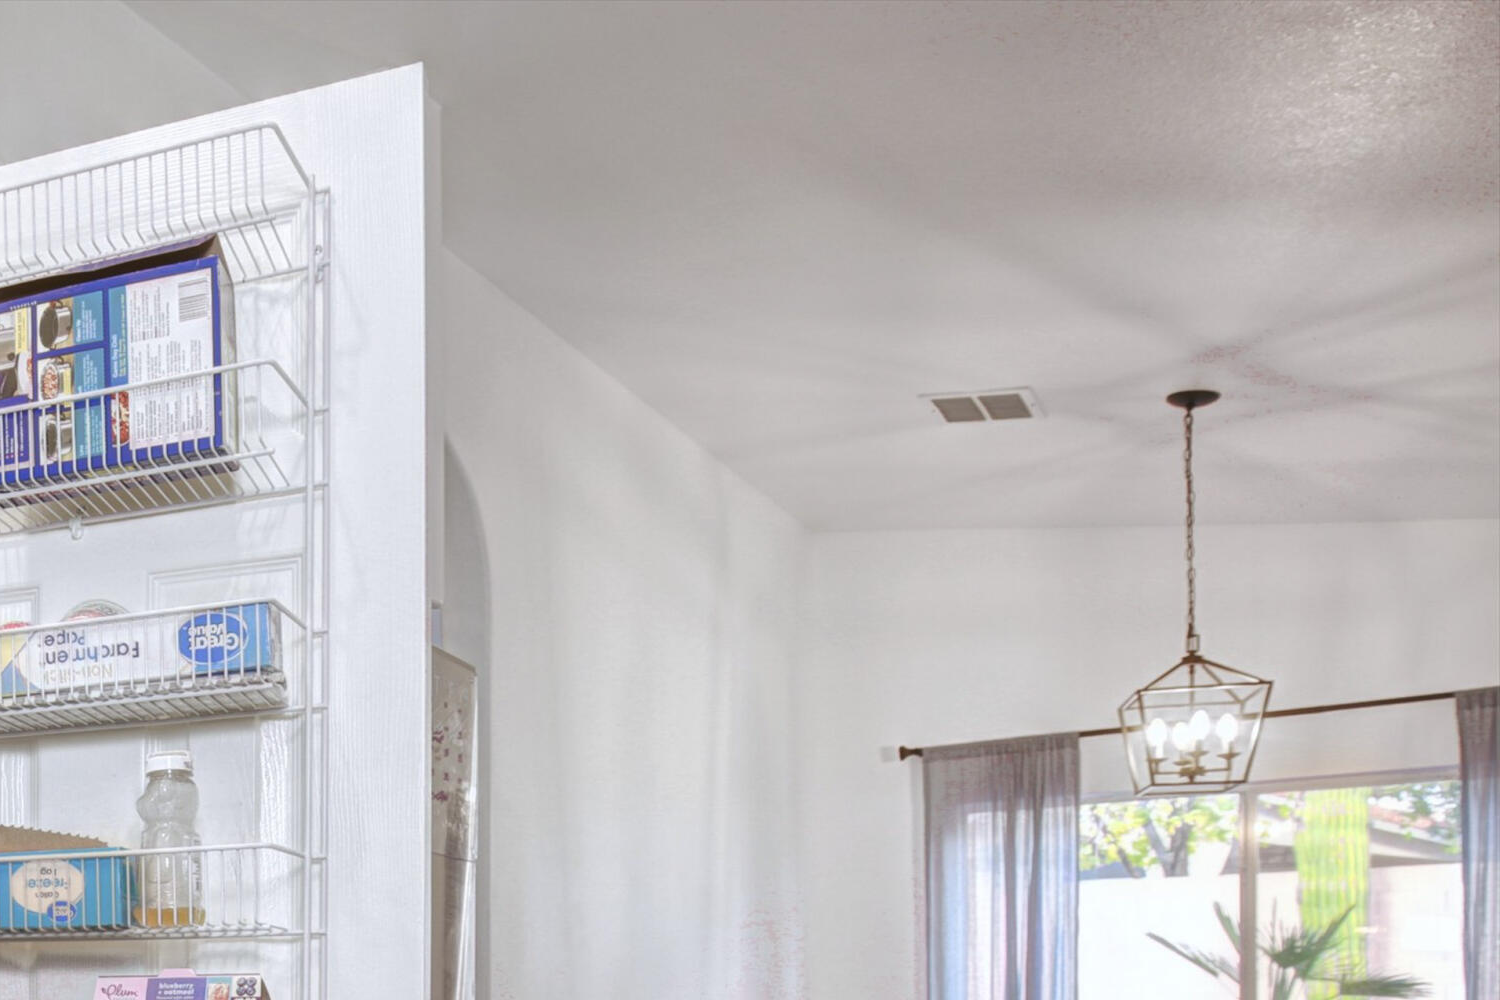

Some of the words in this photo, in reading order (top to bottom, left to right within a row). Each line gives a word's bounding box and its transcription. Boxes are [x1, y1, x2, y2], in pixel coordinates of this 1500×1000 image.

[187, 632, 240, 651] Great
[106, 983, 139, 1000] Plum
[158, 982, 194, 990] blueberry
